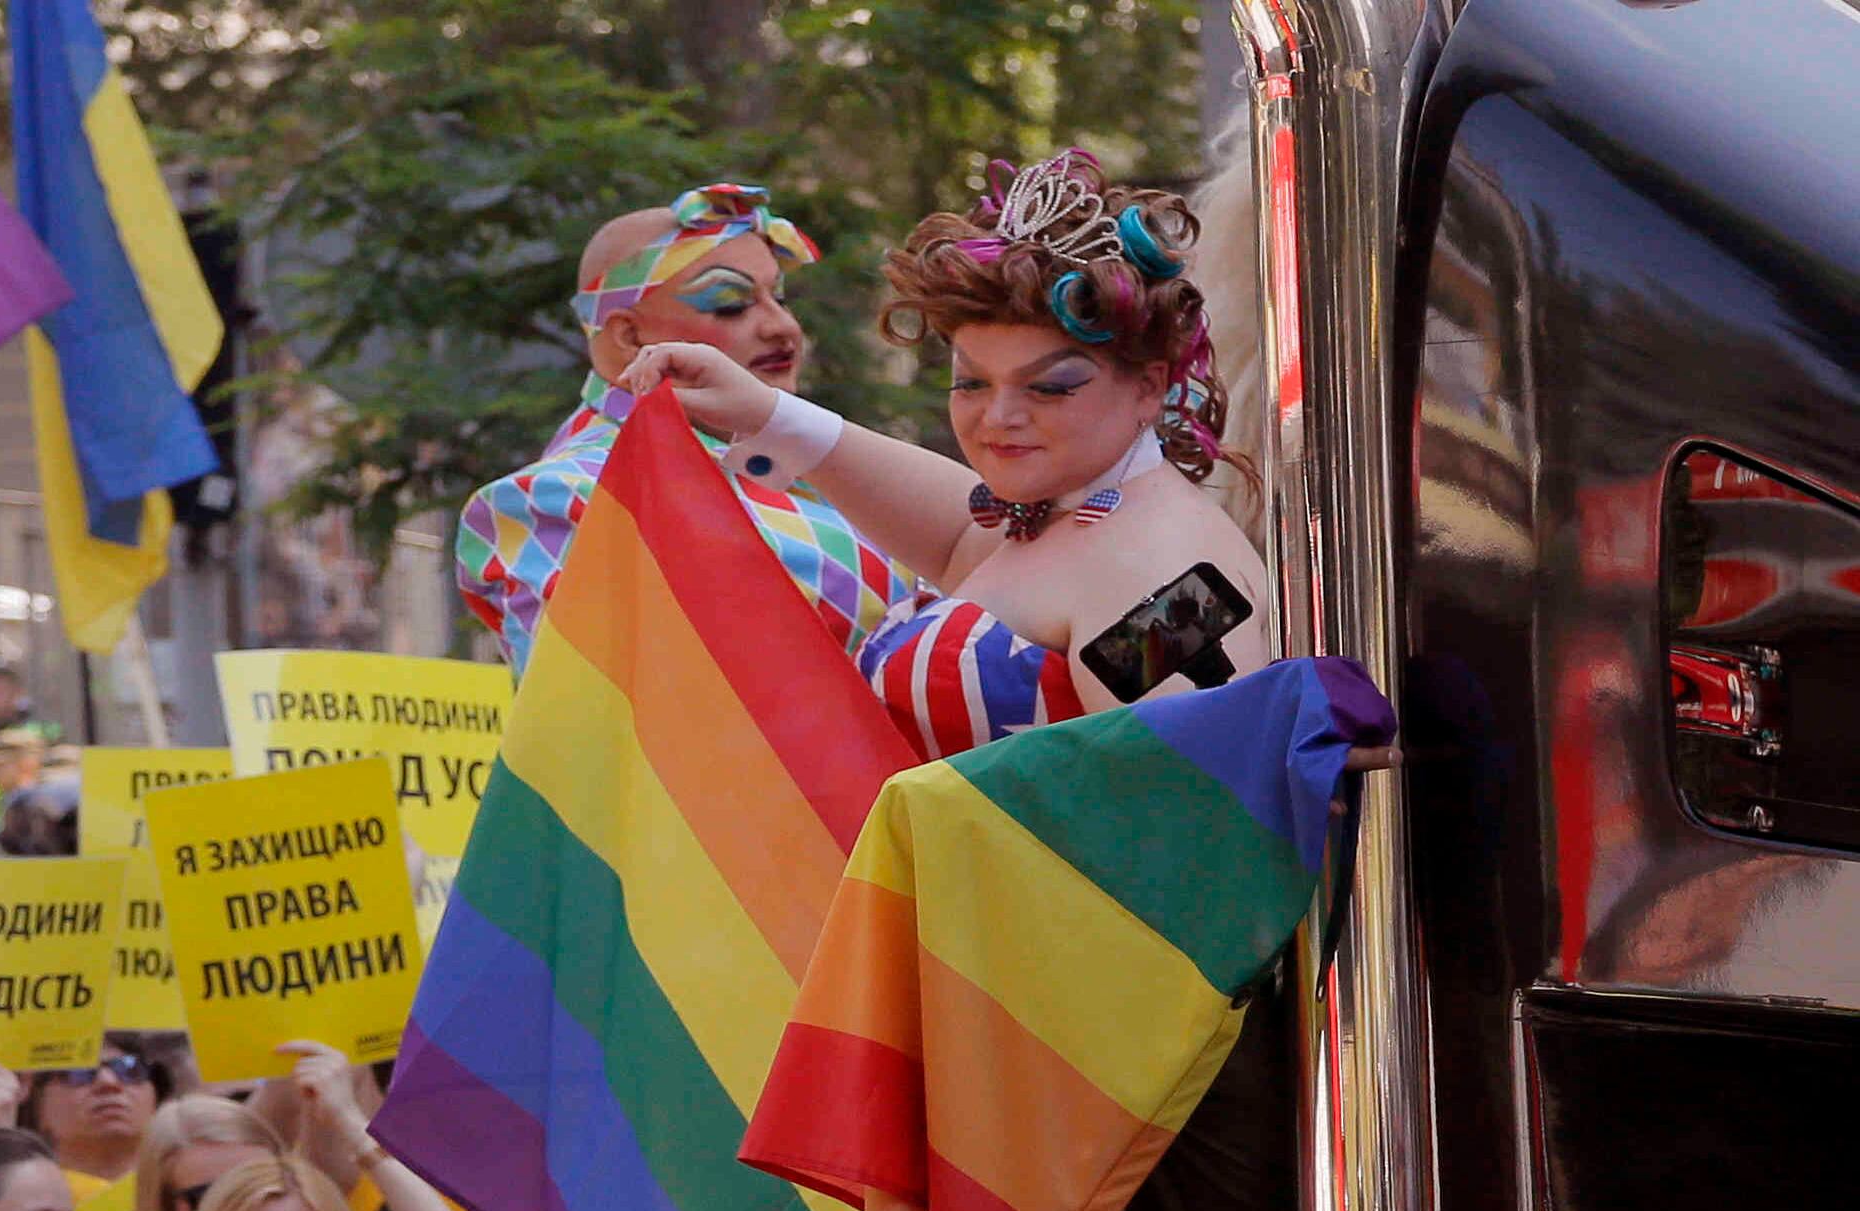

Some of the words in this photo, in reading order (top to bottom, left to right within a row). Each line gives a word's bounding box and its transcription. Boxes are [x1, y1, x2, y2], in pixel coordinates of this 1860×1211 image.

[253, 692, 361, 721] ПРАВА
[371, 694, 503, 734] ЛЮДИНИ
[440, 755, 486, 801] УС
[176, 845, 198, 876] Я
[206, 816, 385, 872] ЗАХИЩАЮ
[225, 880, 359, 930] ПРАВА
[201, 934, 406, 1000] ЛЮДИНИ
